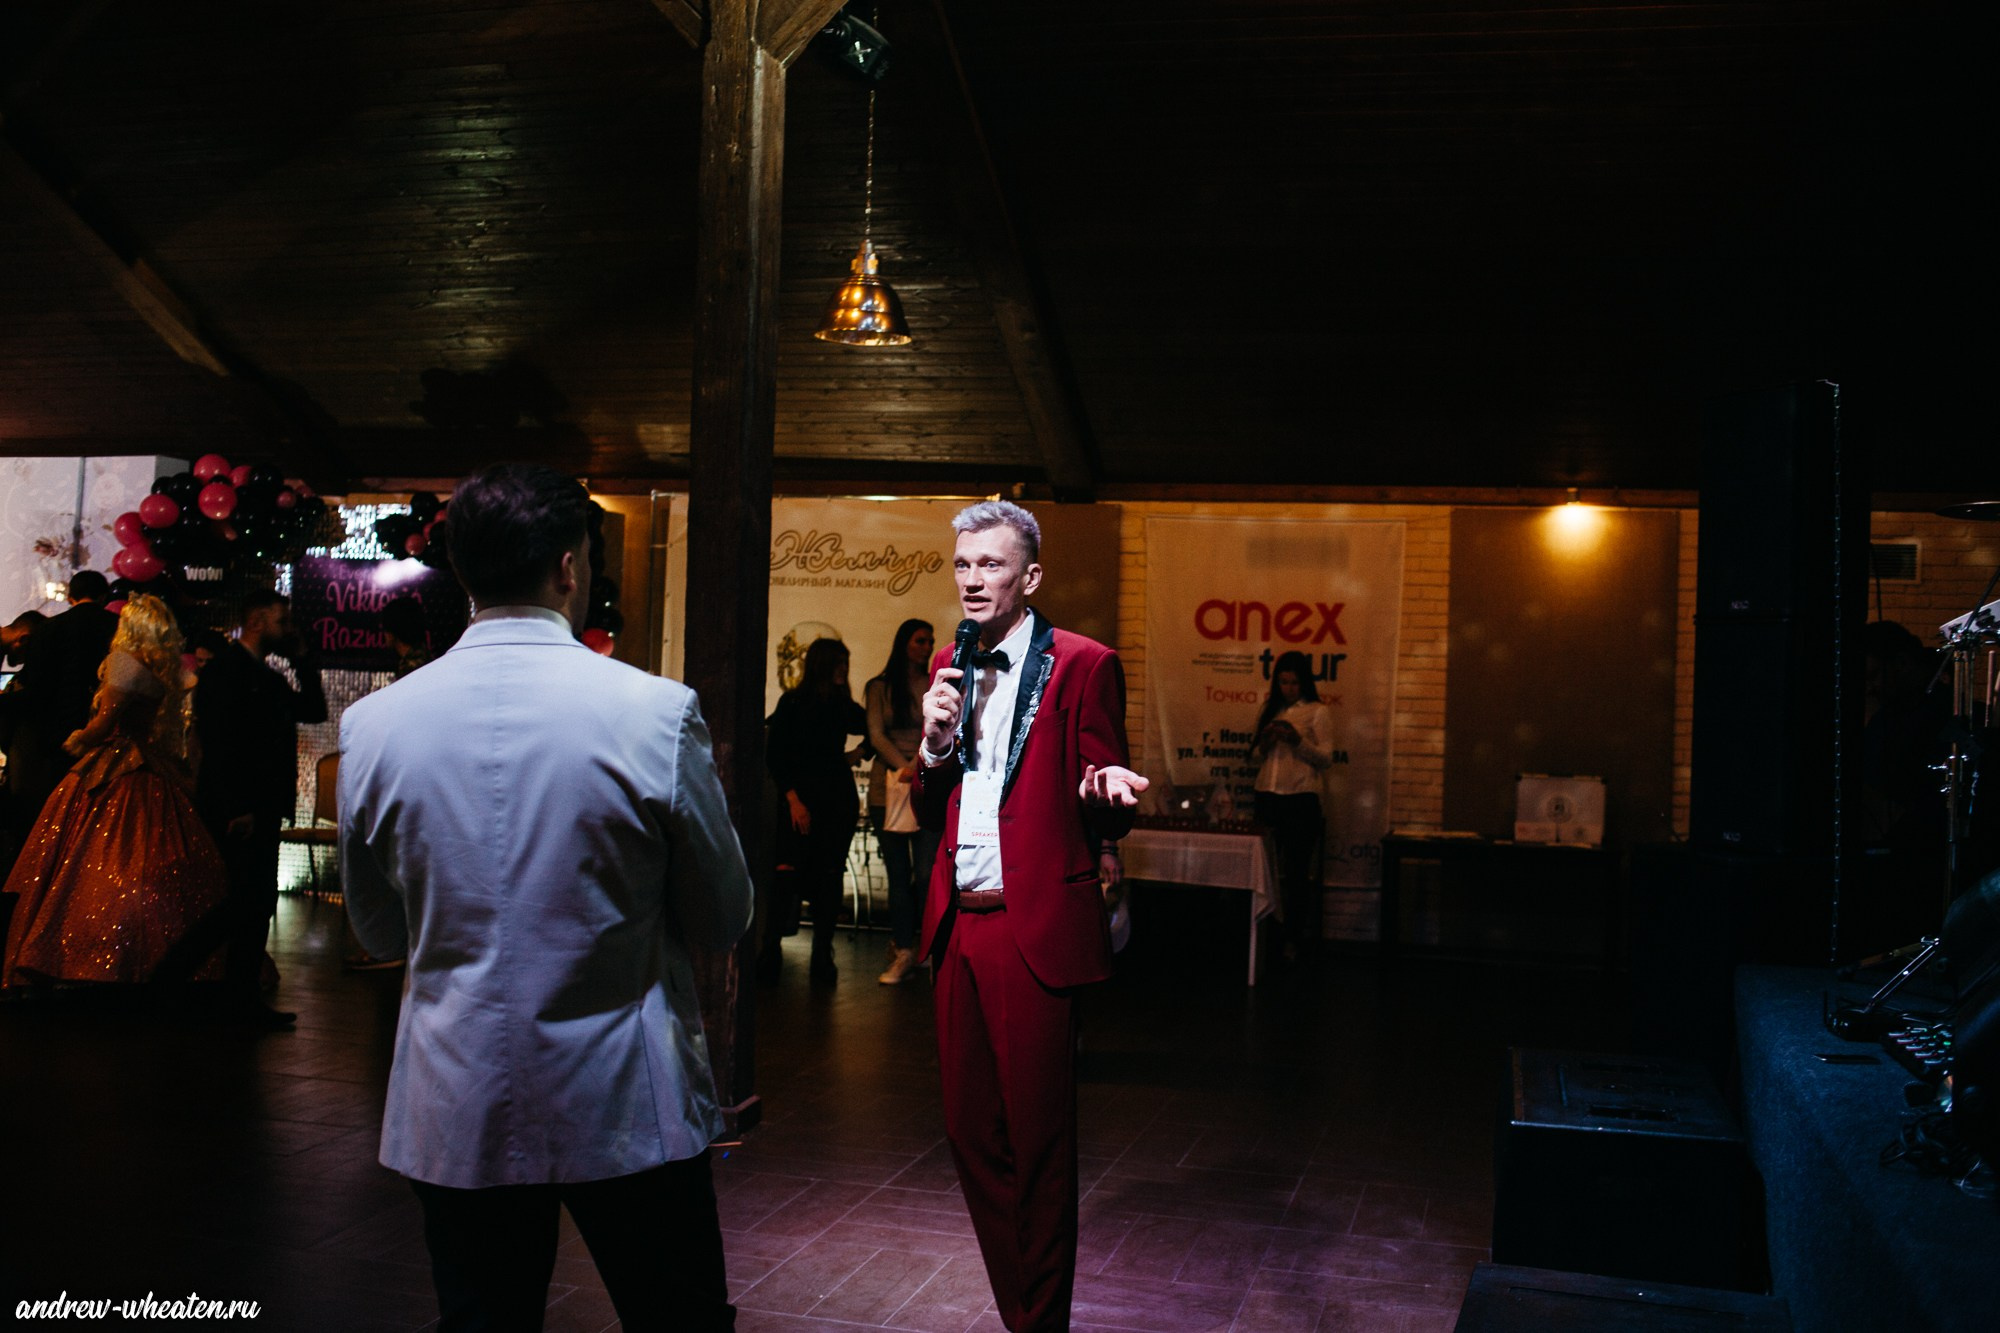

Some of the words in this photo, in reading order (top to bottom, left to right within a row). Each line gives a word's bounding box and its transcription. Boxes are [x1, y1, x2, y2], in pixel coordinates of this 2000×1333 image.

[184, 566, 224, 582] WOW!
[836, 577, 886, 588] МАГАЗИН
[326, 580, 423, 613] Viktoa
[1195, 599, 1346, 645] anex
[1259, 648, 1347, 682] tur
[1206, 685, 1258, 704] Точка
